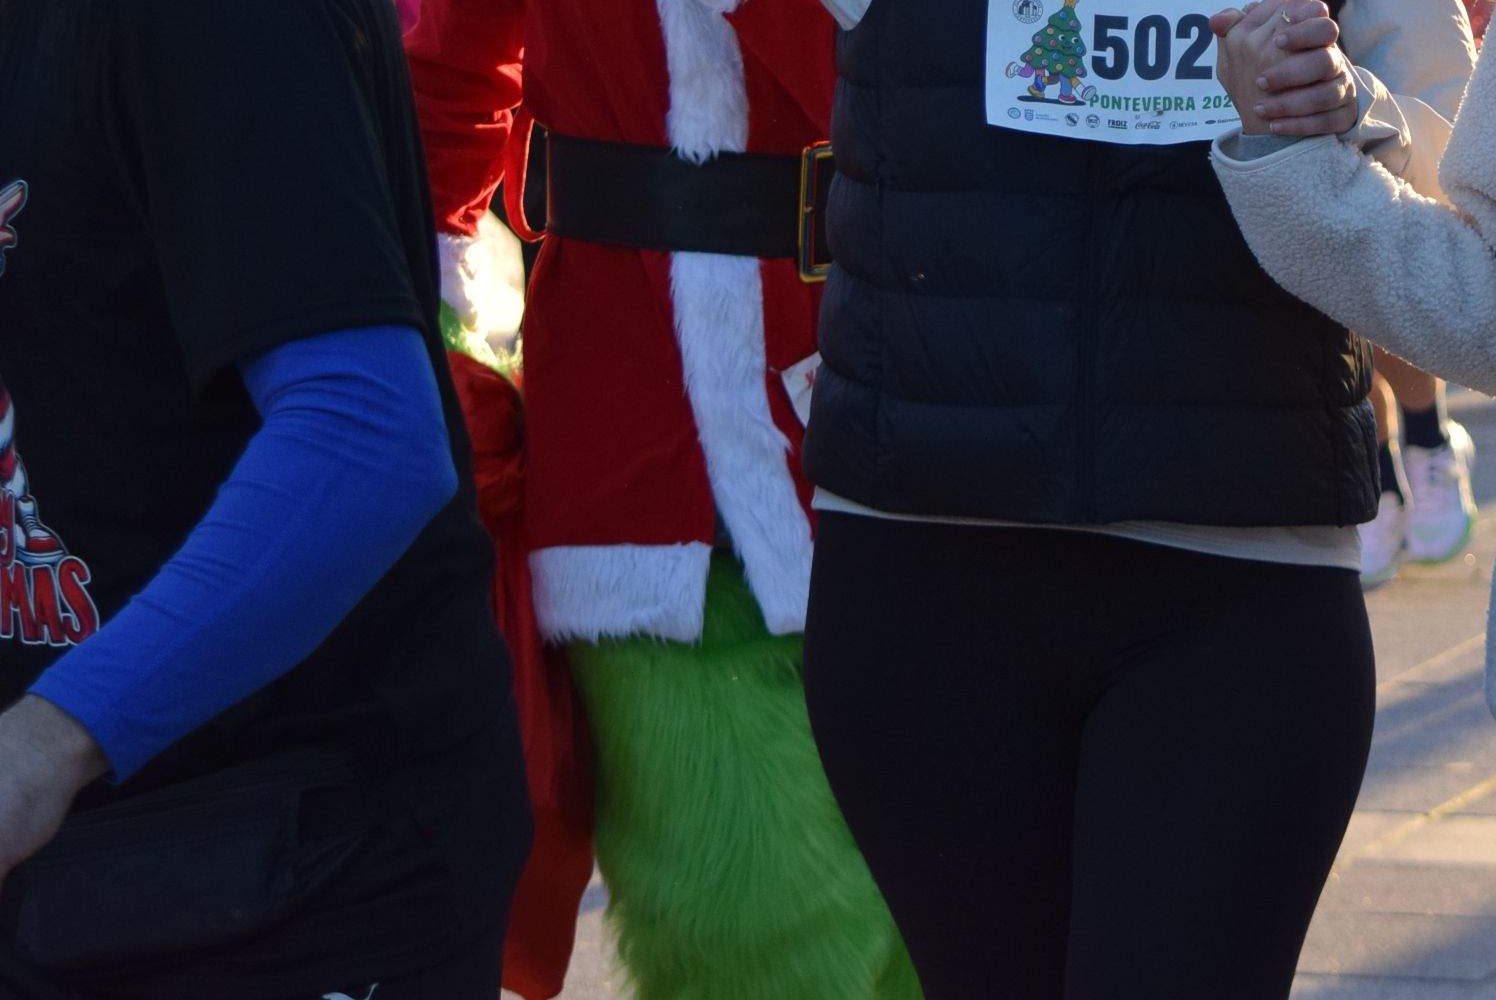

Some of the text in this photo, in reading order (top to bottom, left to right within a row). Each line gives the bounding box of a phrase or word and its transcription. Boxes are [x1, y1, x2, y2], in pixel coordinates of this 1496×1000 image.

[1091, 13, 1214, 81] 502
[1089, 94, 1233, 112] PONTEVEDRA 202
